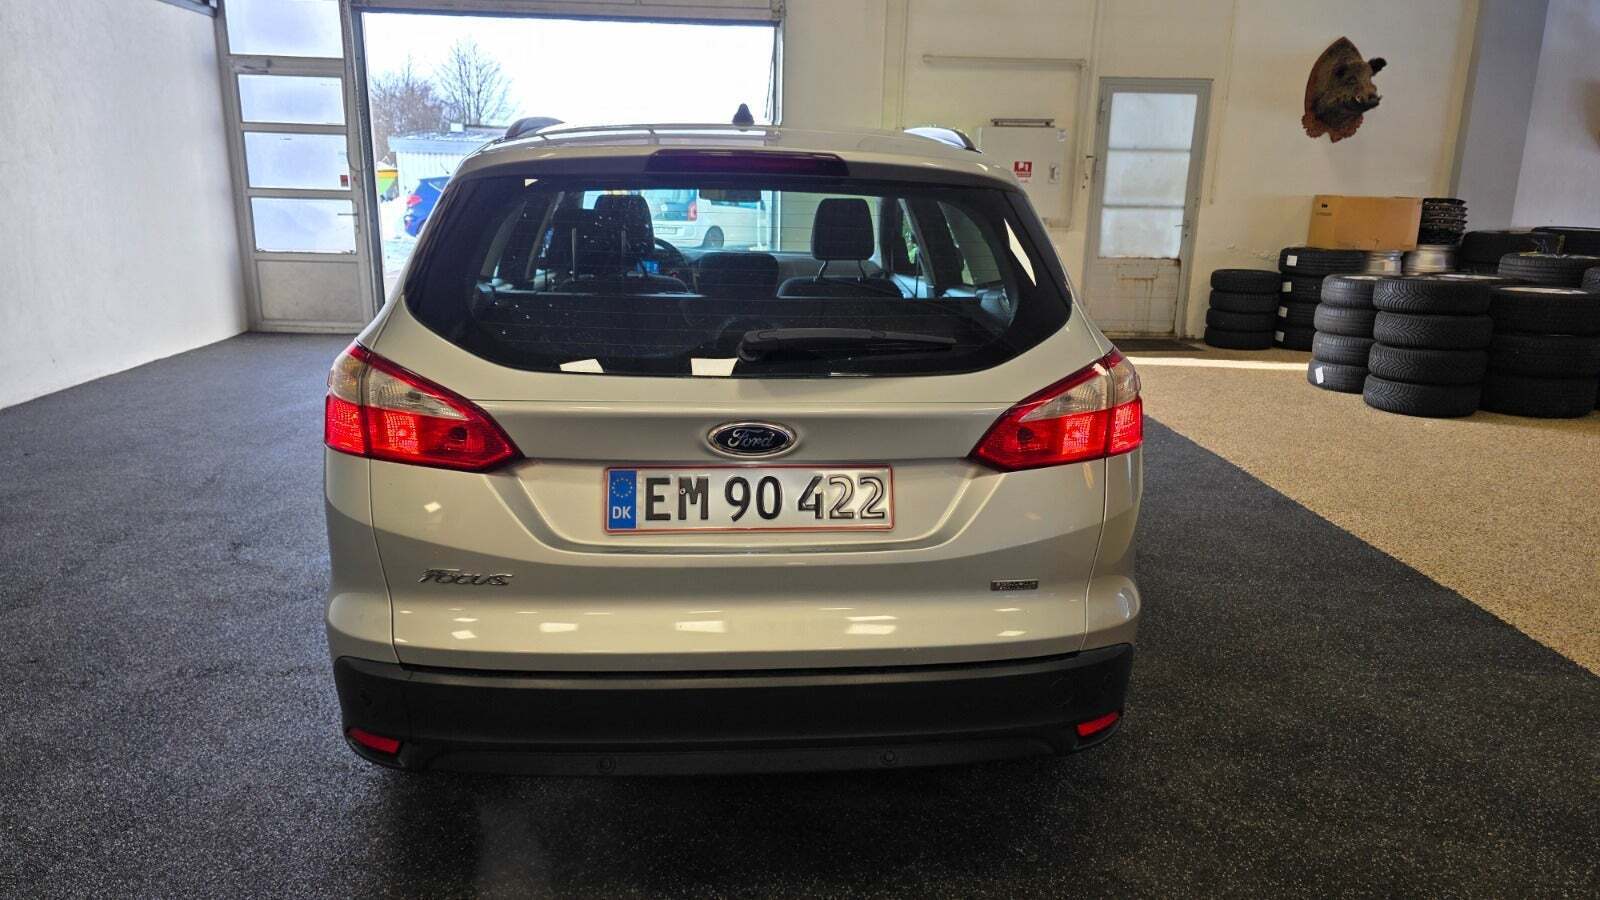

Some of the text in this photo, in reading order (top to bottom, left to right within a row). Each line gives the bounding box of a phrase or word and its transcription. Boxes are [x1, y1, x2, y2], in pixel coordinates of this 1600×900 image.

[728, 429, 775, 448] Ford
[645, 475, 885, 522] EM 90 422
[612, 506, 632, 519] DK
